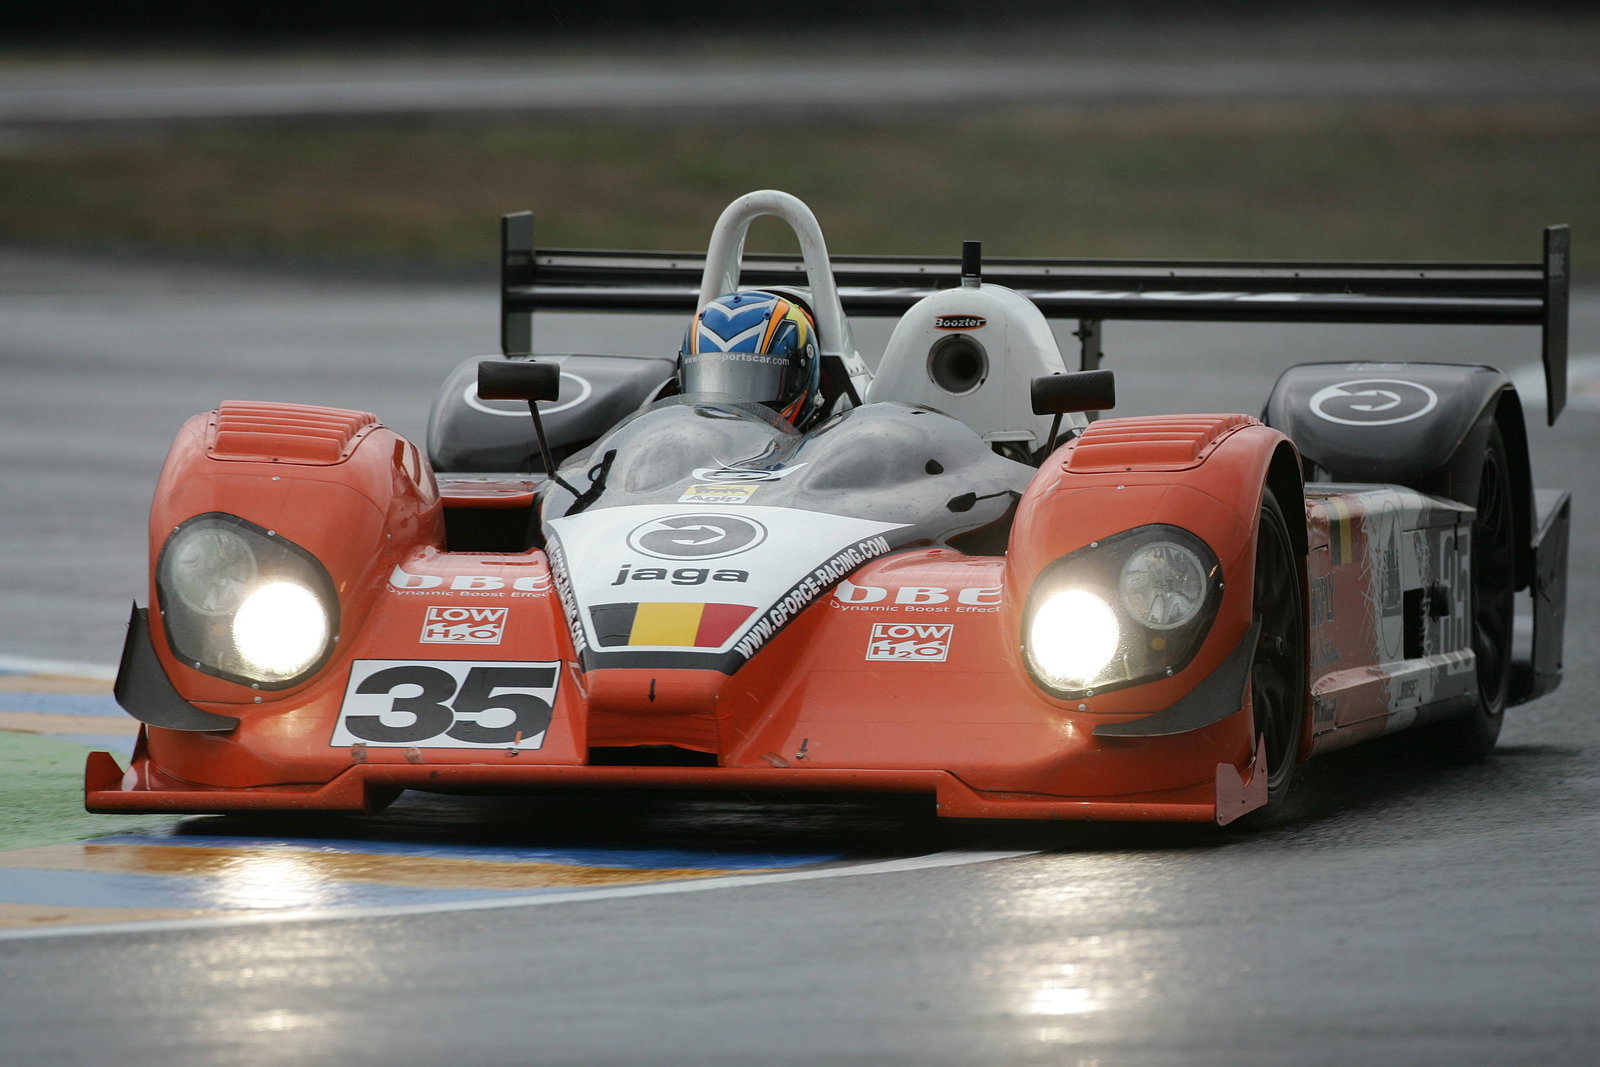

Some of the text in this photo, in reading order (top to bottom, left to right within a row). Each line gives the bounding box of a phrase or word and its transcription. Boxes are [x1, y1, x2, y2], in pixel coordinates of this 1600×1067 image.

[935, 318, 986, 327] Boozter
[686, 495, 742, 503] Agip
[611, 564, 749, 586] jaga
[386, 584, 454, 597] Dynamic
[834, 580, 1003, 605] DBE
[734, 536, 891, 660] WWW.GFORCE-RACING.COM
[830, 600, 899, 612] Dynamic
[905, 605, 950, 613] Boost
[429, 609, 505, 622] LOW
[427, 629, 498, 641] H2O
[875, 625, 951, 639] LOW
[872, 646, 943, 659] H2O
[345, 665, 557, 744] 35
